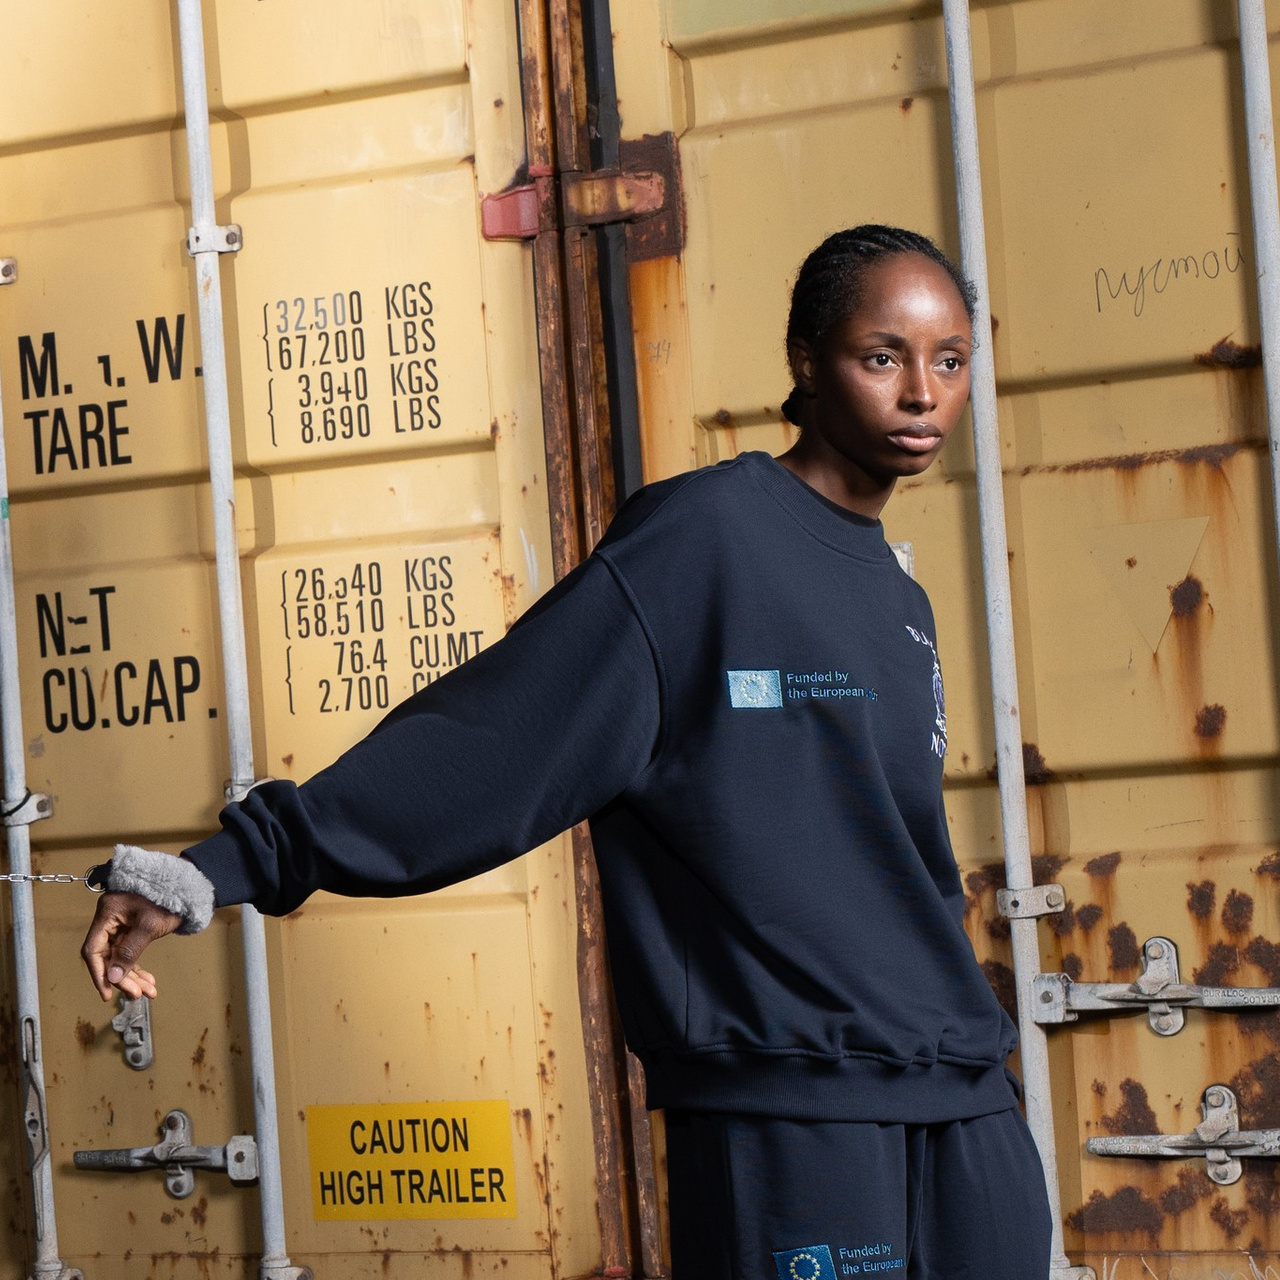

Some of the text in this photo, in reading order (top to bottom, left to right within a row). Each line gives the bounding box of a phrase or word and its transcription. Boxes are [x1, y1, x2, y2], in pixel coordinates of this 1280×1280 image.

[275, 282, 435, 335] 32,500 KGS
[18, 331, 73, 400] M.
[278, 317, 437, 371] 67,200 LBS
[298, 357, 439, 408] 3,940 KGS
[23, 399, 133, 475] TARE
[300, 394, 442, 443] 8,690 LBS
[293, 555, 455, 603] 26,540 KGS
[295, 592, 457, 640] 58,510 LBS
[332, 630, 484, 676] 76.4 CU.MT
[318, 673, 391, 713] 2,700
[786, 670, 849, 684] Funded by
[787, 687, 808, 699] the
[810, 686, 864, 700] European
[350, 1117, 470, 1156] CAUTION
[319, 1167, 507, 1206] HIGH TRAILER
[838, 1243, 893, 1260] Funded by
[841, 1262, 860, 1276] the
[862, 1257, 904, 1273] European
